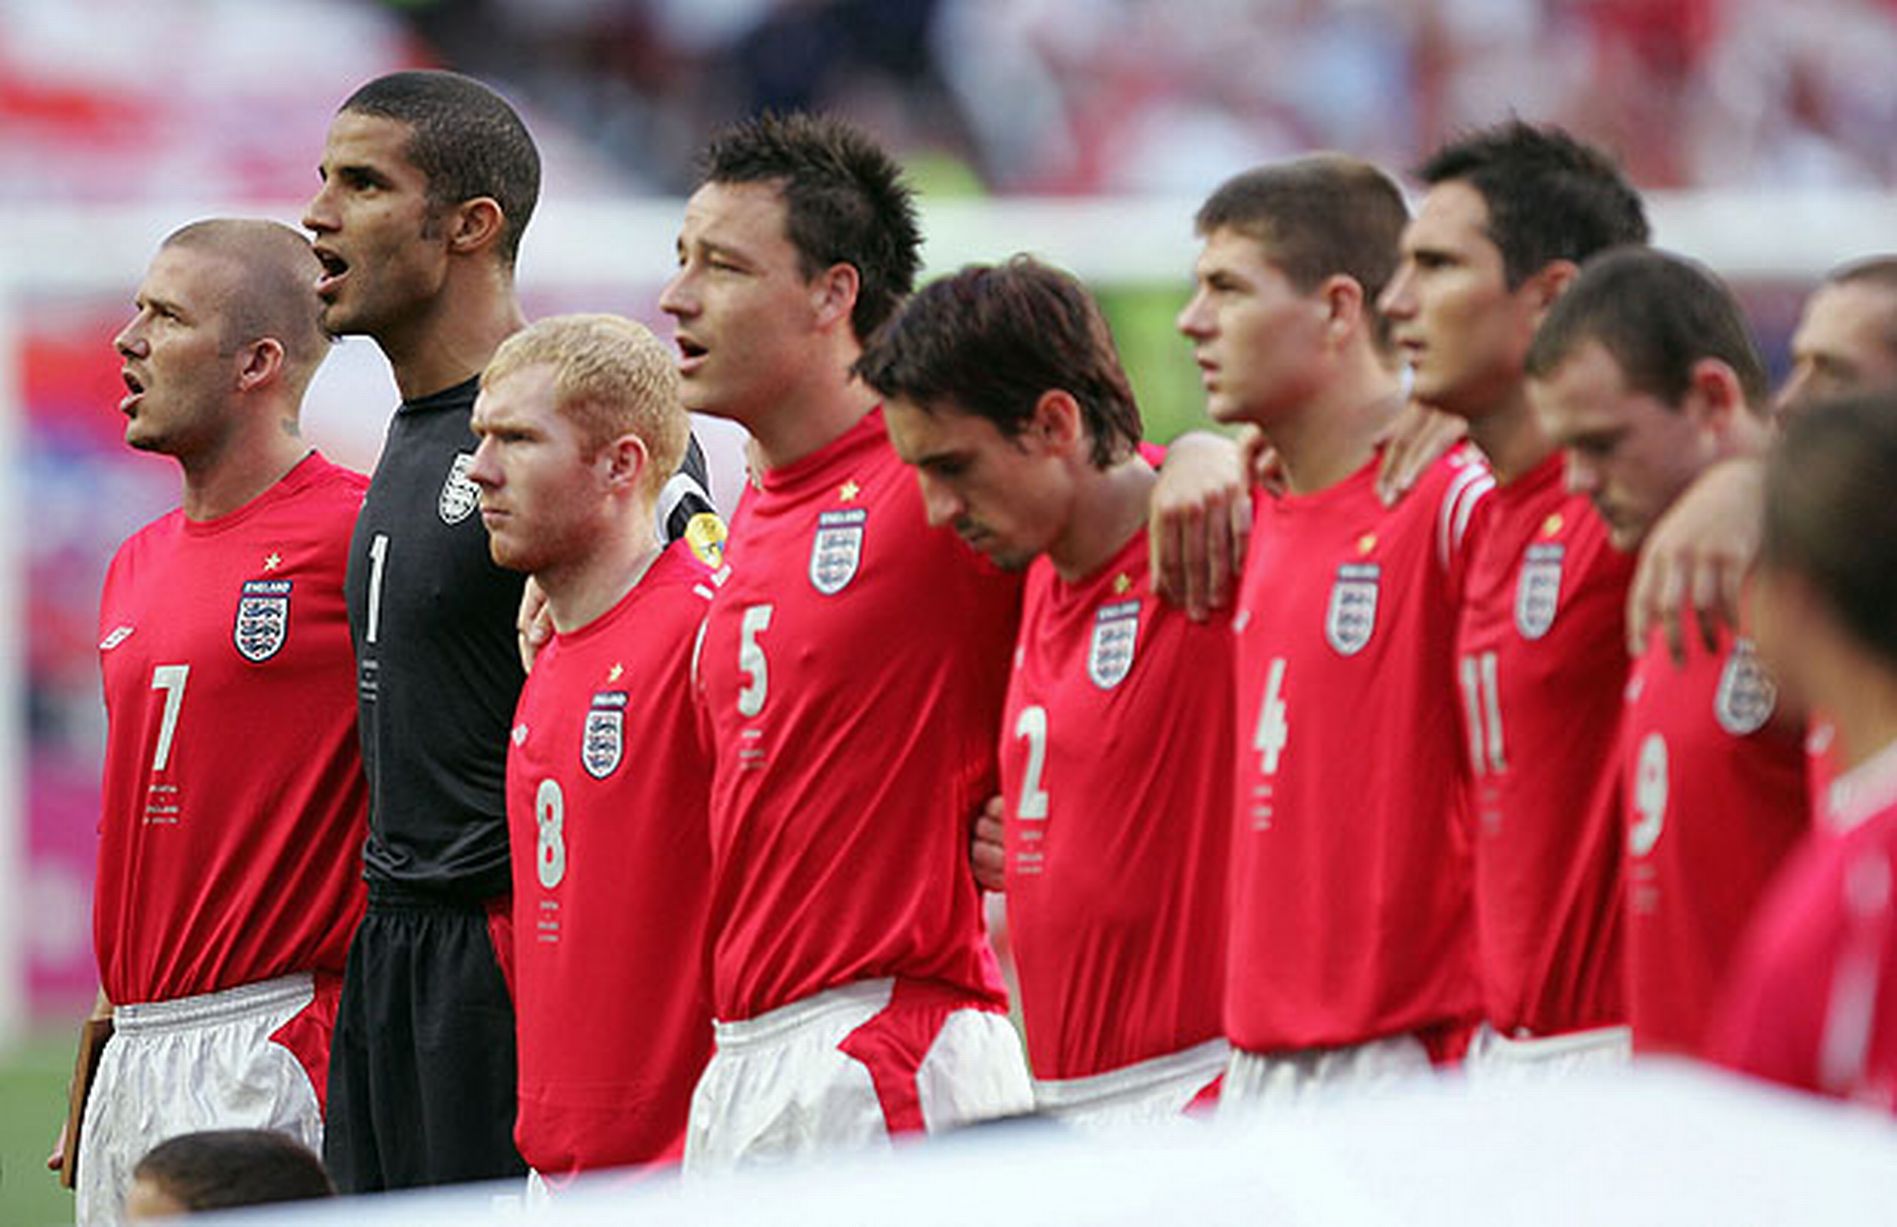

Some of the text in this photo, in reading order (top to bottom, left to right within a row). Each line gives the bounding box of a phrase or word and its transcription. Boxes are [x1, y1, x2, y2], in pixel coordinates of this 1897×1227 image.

[243, 581, 292, 592] ENGLAND
[367, 535, 389, 642] 1
[738, 604, 773, 717] 5
[1254, 657, 1288, 775] 4
[1462, 652, 1507, 777] 11
[152, 665, 190, 771] 7
[1016, 705, 1048, 819] 2
[536, 779, 566, 889] 8
[1629, 732, 1669, 857] 9
